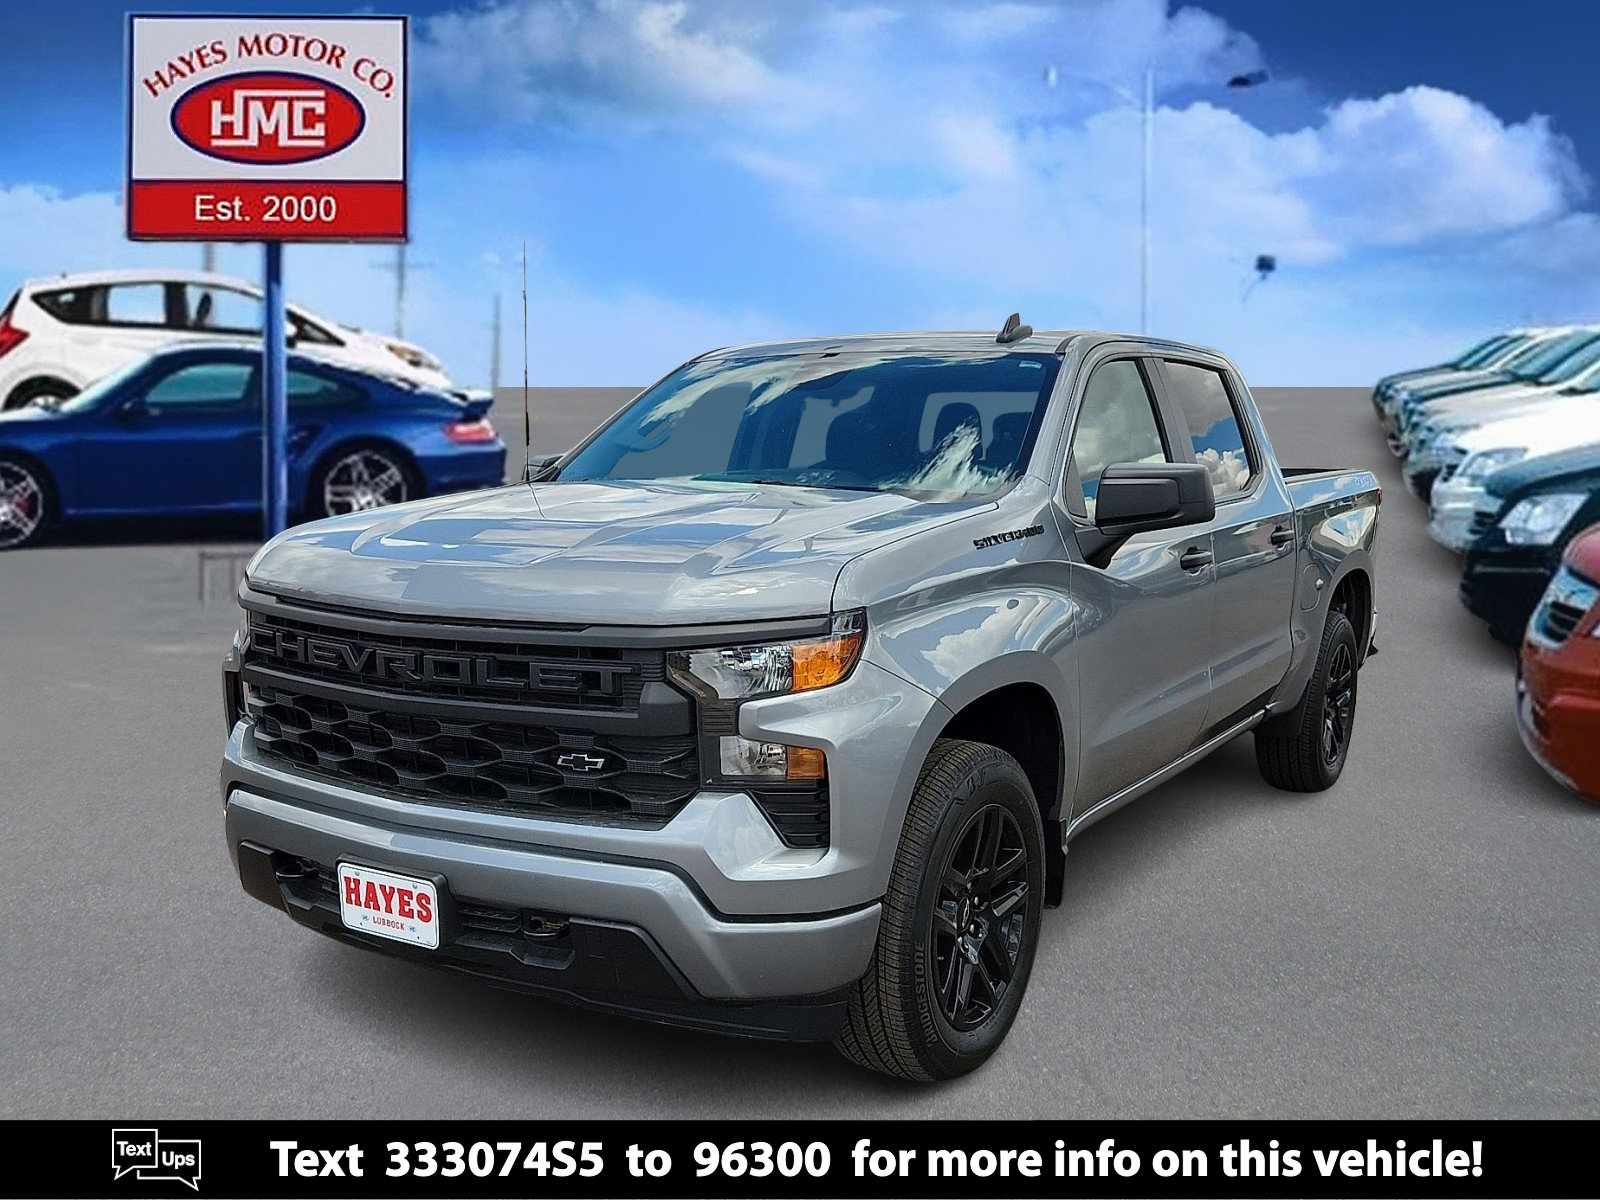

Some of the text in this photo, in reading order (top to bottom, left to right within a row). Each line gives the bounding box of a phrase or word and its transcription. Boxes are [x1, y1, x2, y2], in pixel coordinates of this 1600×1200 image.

[142, 32, 394, 98] HAYES MOTOR CO.
[210, 88, 327, 148] HMC
[194, 195, 337, 222] Est. 2000
[249, 622, 641, 695] CHEVROLET
[343, 875, 433, 923] HAYES
[372, 915, 405, 931] LUBBOCK
